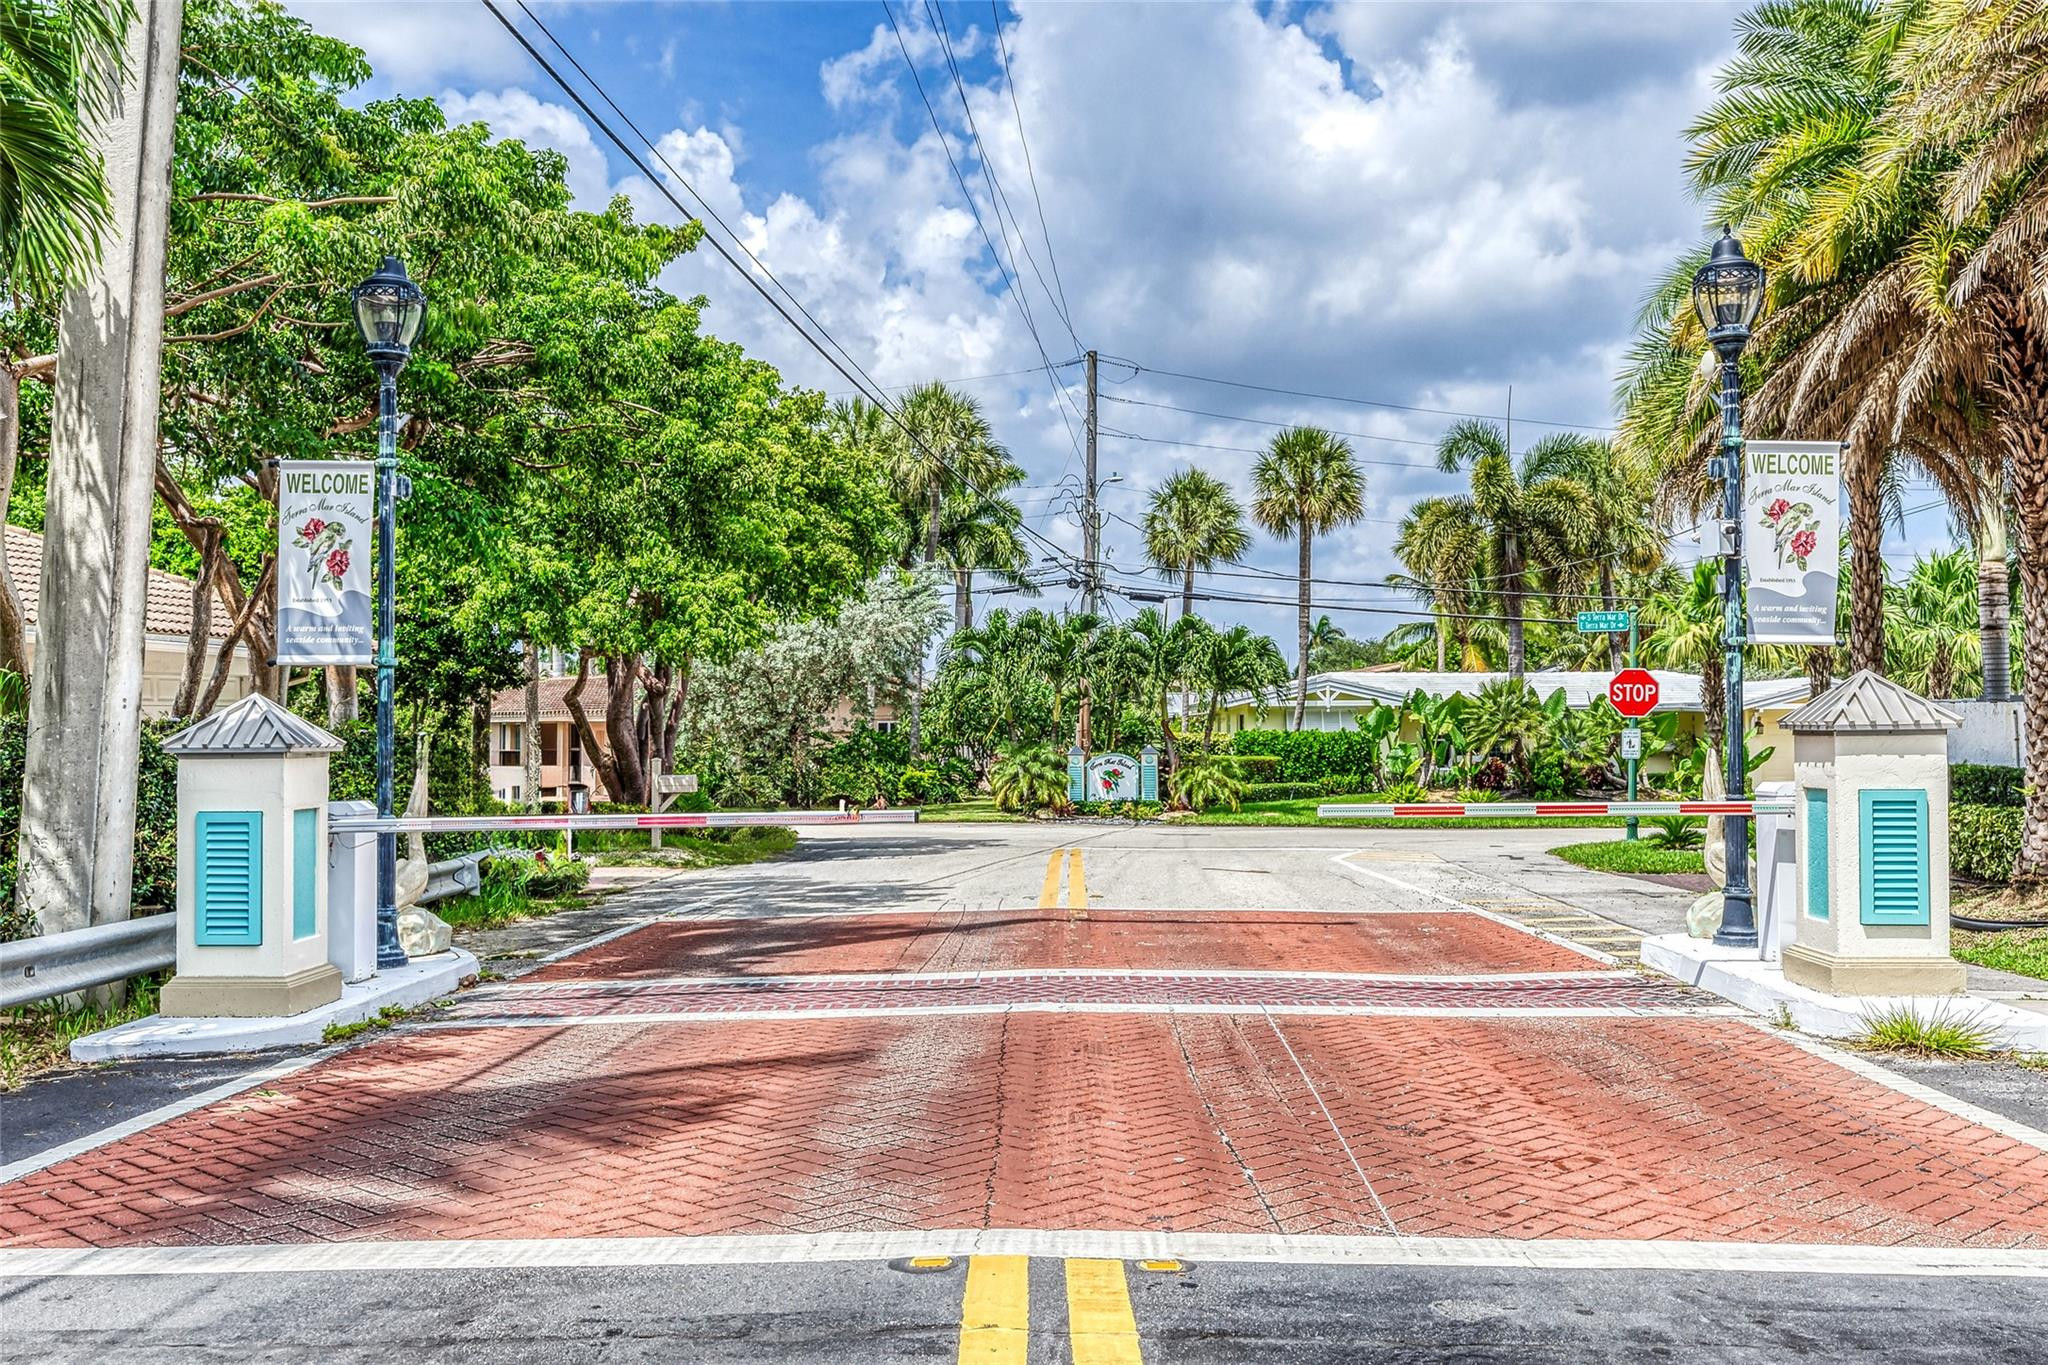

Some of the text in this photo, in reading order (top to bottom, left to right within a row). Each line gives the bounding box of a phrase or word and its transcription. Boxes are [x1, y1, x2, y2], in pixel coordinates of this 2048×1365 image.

[1751, 453, 1834, 475] WELCOME
[286, 473, 369, 494] WELCOME
[1748, 479, 1837, 506] Terra Mar Island
[281, 496, 370, 526] Terra Mar Island
[1784, 604, 1799, 612] and
[1799, 604, 1828, 614] inviting
[1592, 613, 1606, 621] Terra
[1607, 613, 1617, 621] Mar
[1618, 612, 1626, 621] Dr
[1753, 615, 1782, 624] seaside
[318, 624, 333, 632] and
[1585, 621, 1598, 629] Terra
[1599, 621, 1609, 629] Mar
[1610, 621, 1616, 629] Dr
[285, 636, 315, 644] seaside
[1612, 683, 1657, 702] STOP
[1117, 759, 1135, 770] Island
